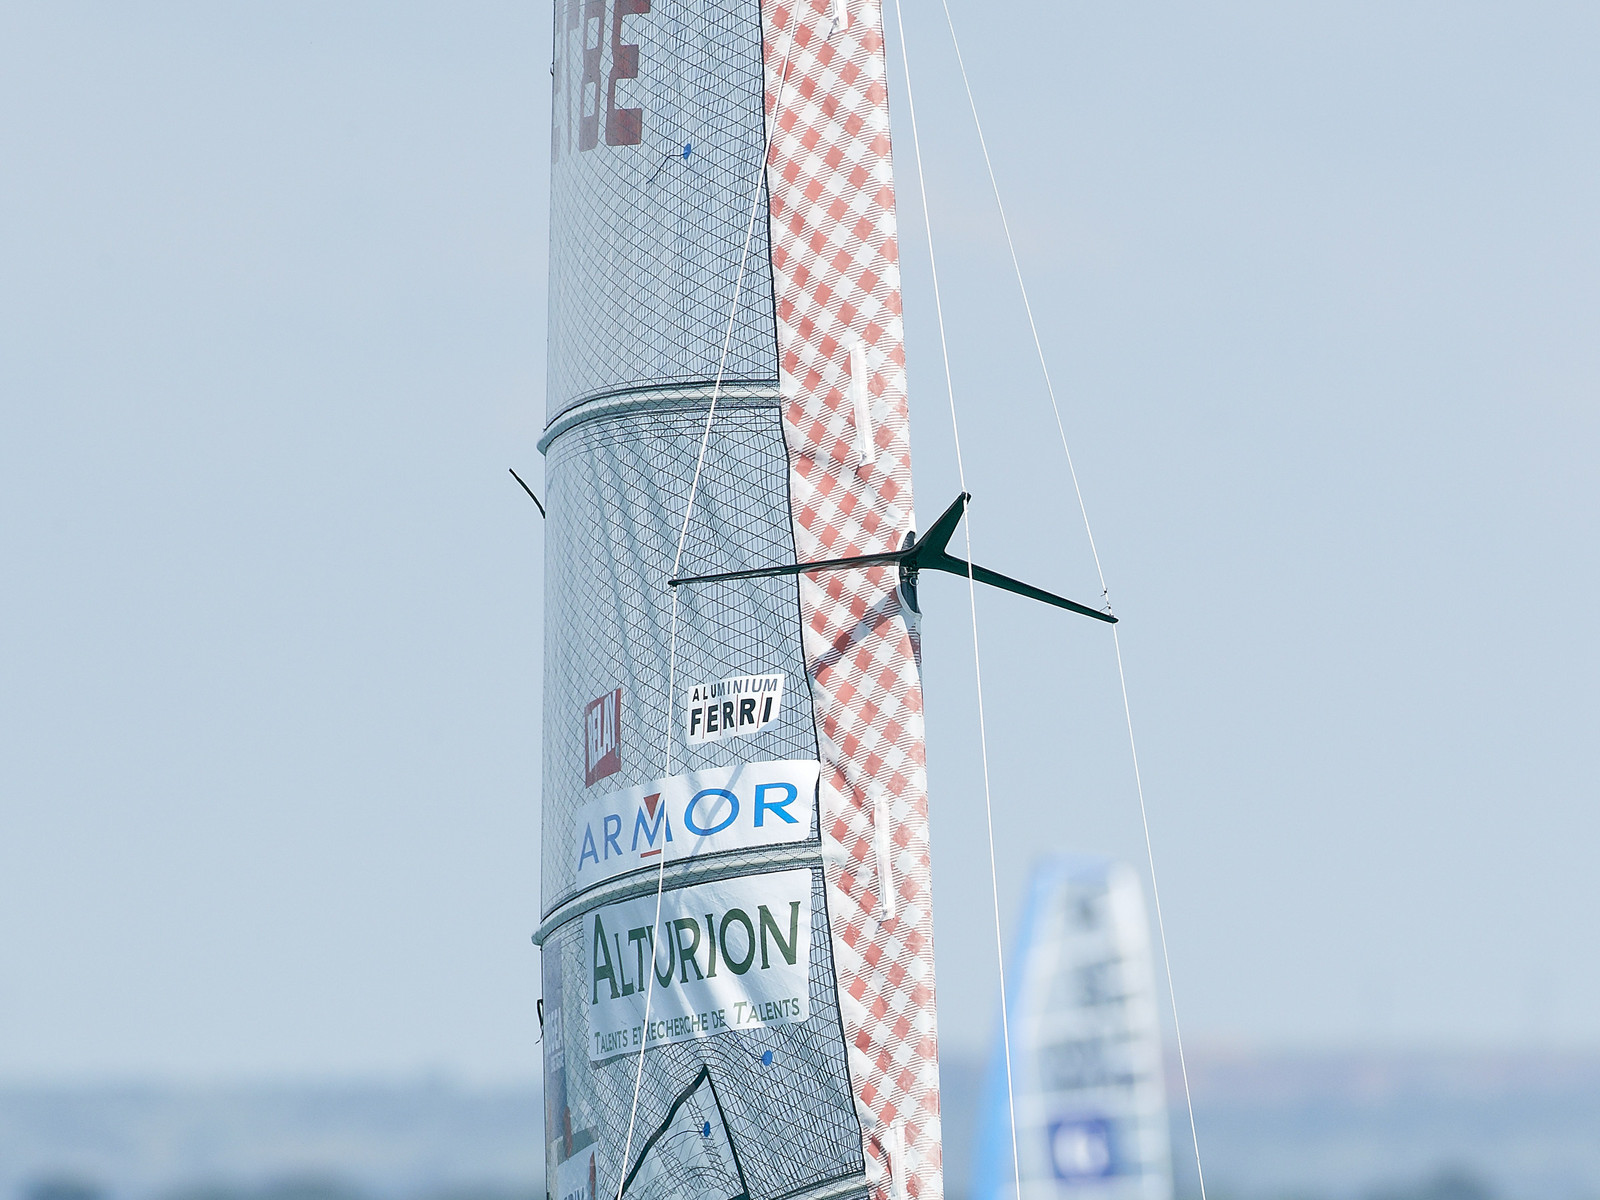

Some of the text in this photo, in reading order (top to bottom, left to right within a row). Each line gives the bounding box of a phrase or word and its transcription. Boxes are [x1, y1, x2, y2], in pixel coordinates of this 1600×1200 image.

[690, 697, 773, 736] FERRI
[692, 678, 778, 702] ALUMINIUM
[577, 782, 800, 872] ARMOR
[592, 901, 800, 1005] ALTURION
[594, 1029, 628, 1055] TALENTS
[712, 1009, 726, 1029] DE
[733, 997, 800, 1026] TALENTS
